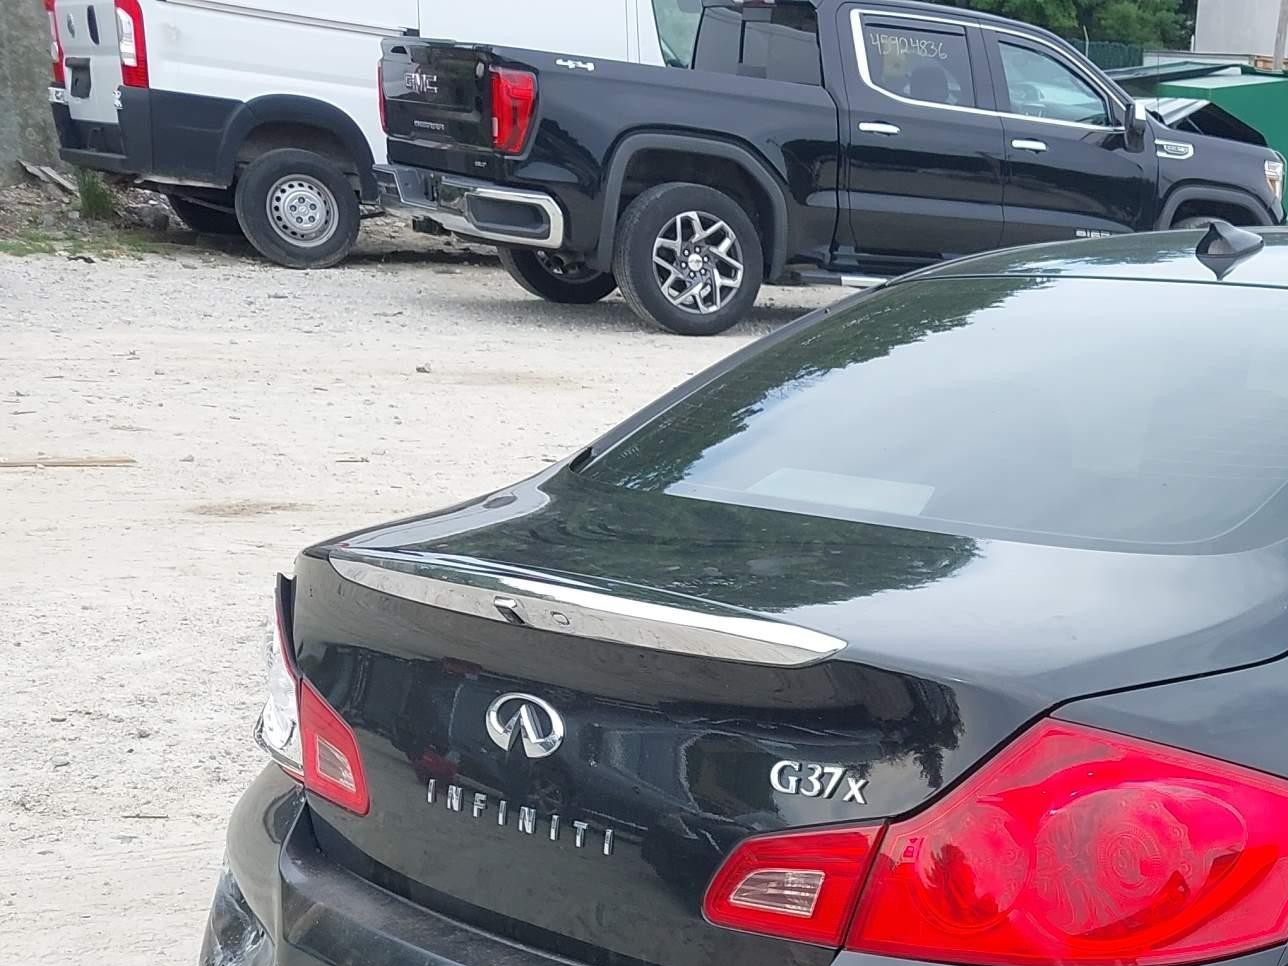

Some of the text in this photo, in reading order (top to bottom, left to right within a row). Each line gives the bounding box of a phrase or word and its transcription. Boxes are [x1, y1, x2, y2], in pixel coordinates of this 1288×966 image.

[869, 32, 948, 60] 45924836
[404, 72, 438, 94] GMC
[427, 778, 615, 856] INFINITI
